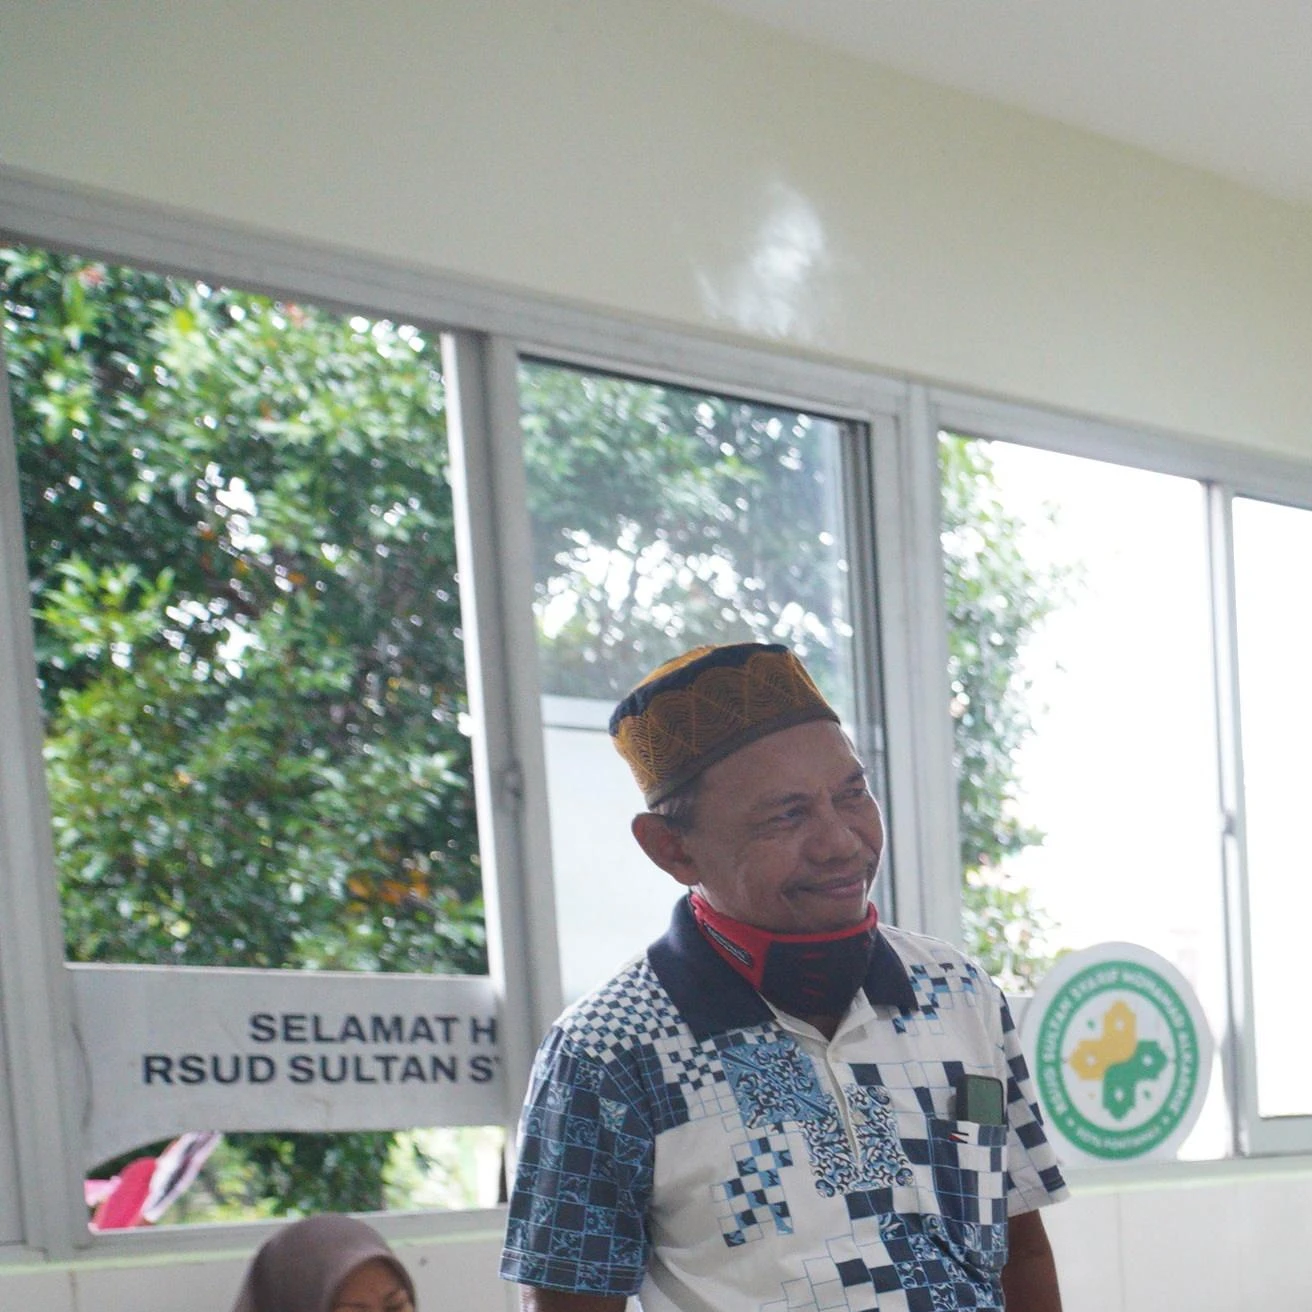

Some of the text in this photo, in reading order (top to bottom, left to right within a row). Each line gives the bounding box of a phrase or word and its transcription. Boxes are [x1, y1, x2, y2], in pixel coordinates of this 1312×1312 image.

[250, 1014, 459, 1043] SELAMAT
[143, 1055, 501, 1084] RSUD SULTAN S
